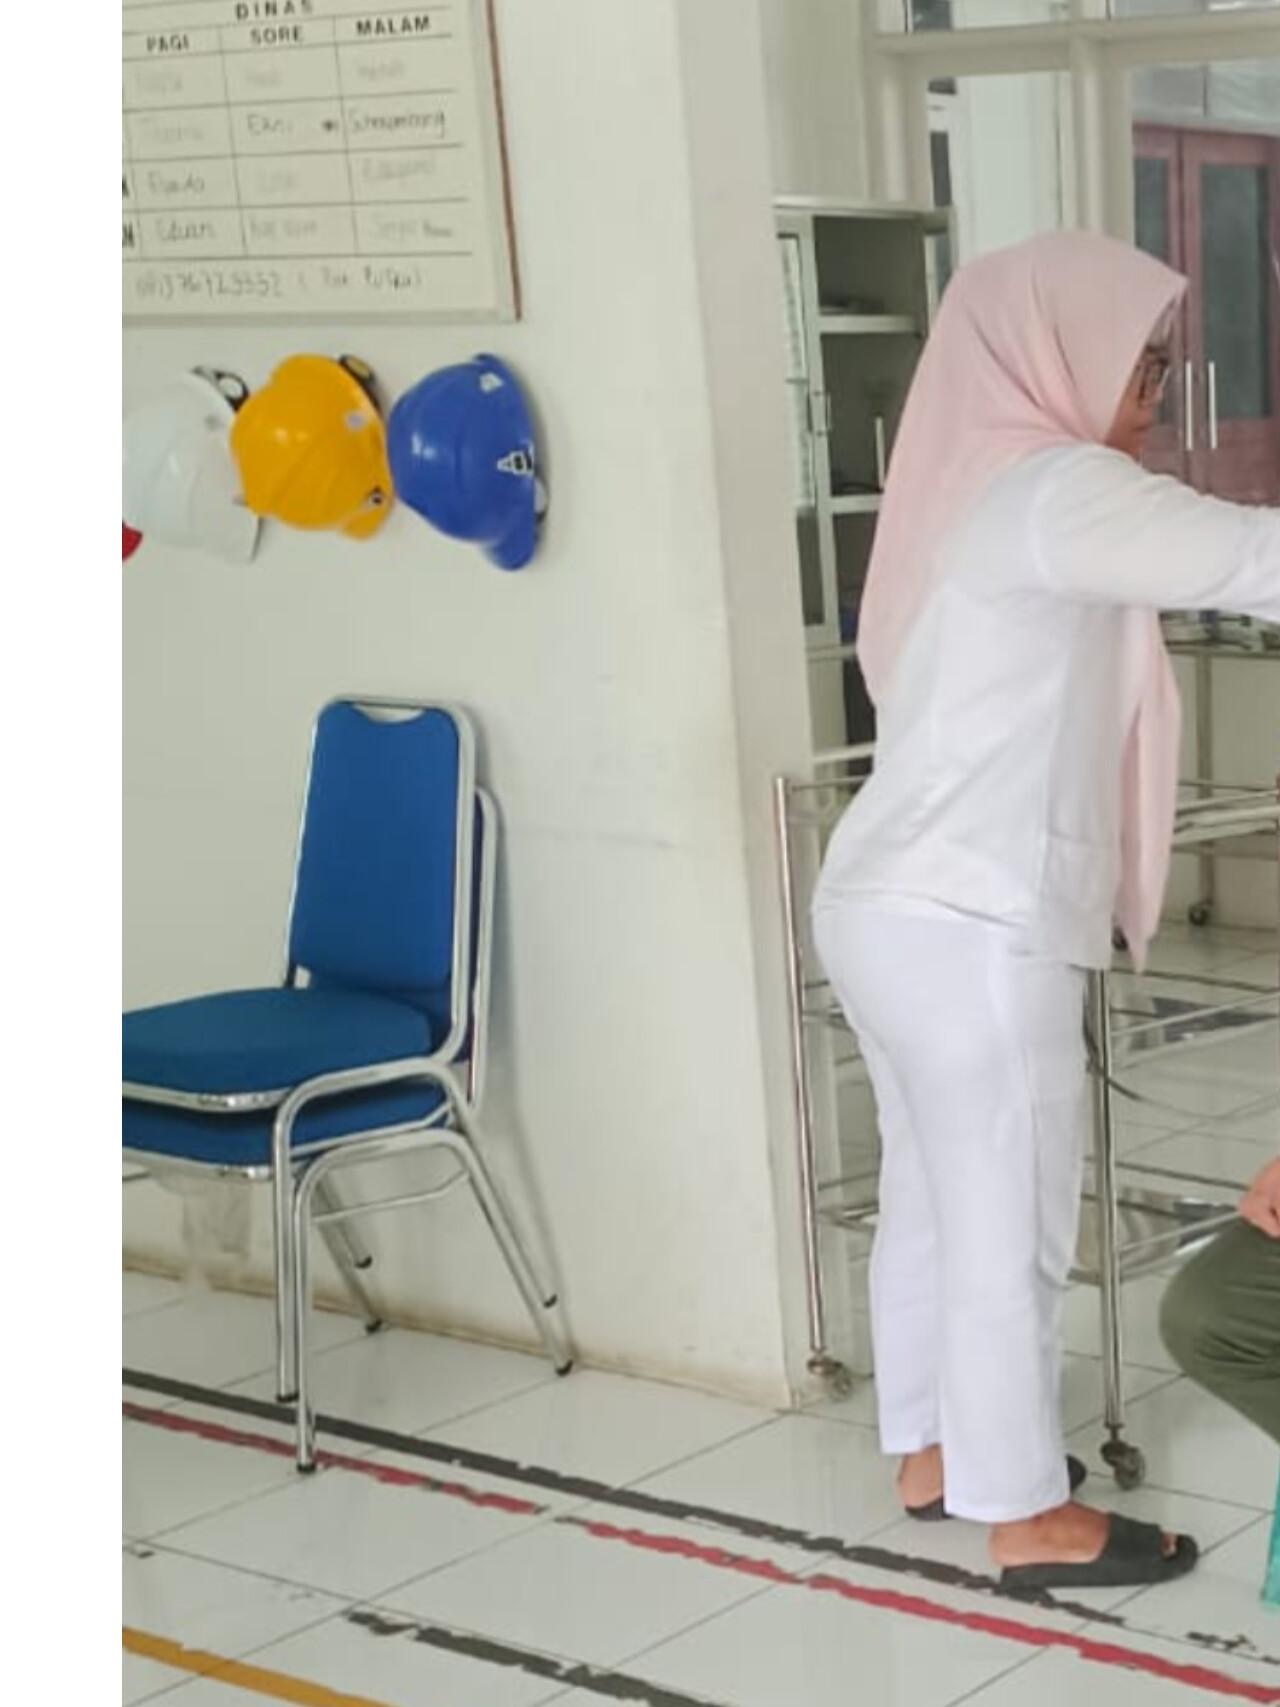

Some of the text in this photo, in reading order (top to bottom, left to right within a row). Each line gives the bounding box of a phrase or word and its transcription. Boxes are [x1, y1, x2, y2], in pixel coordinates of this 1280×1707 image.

[235, 0, 314, 20] DINAS
[250, 25, 304, 45] SORE
[356, 16, 430, 36] MALAM
[146, 34, 190, 52] PAGI
